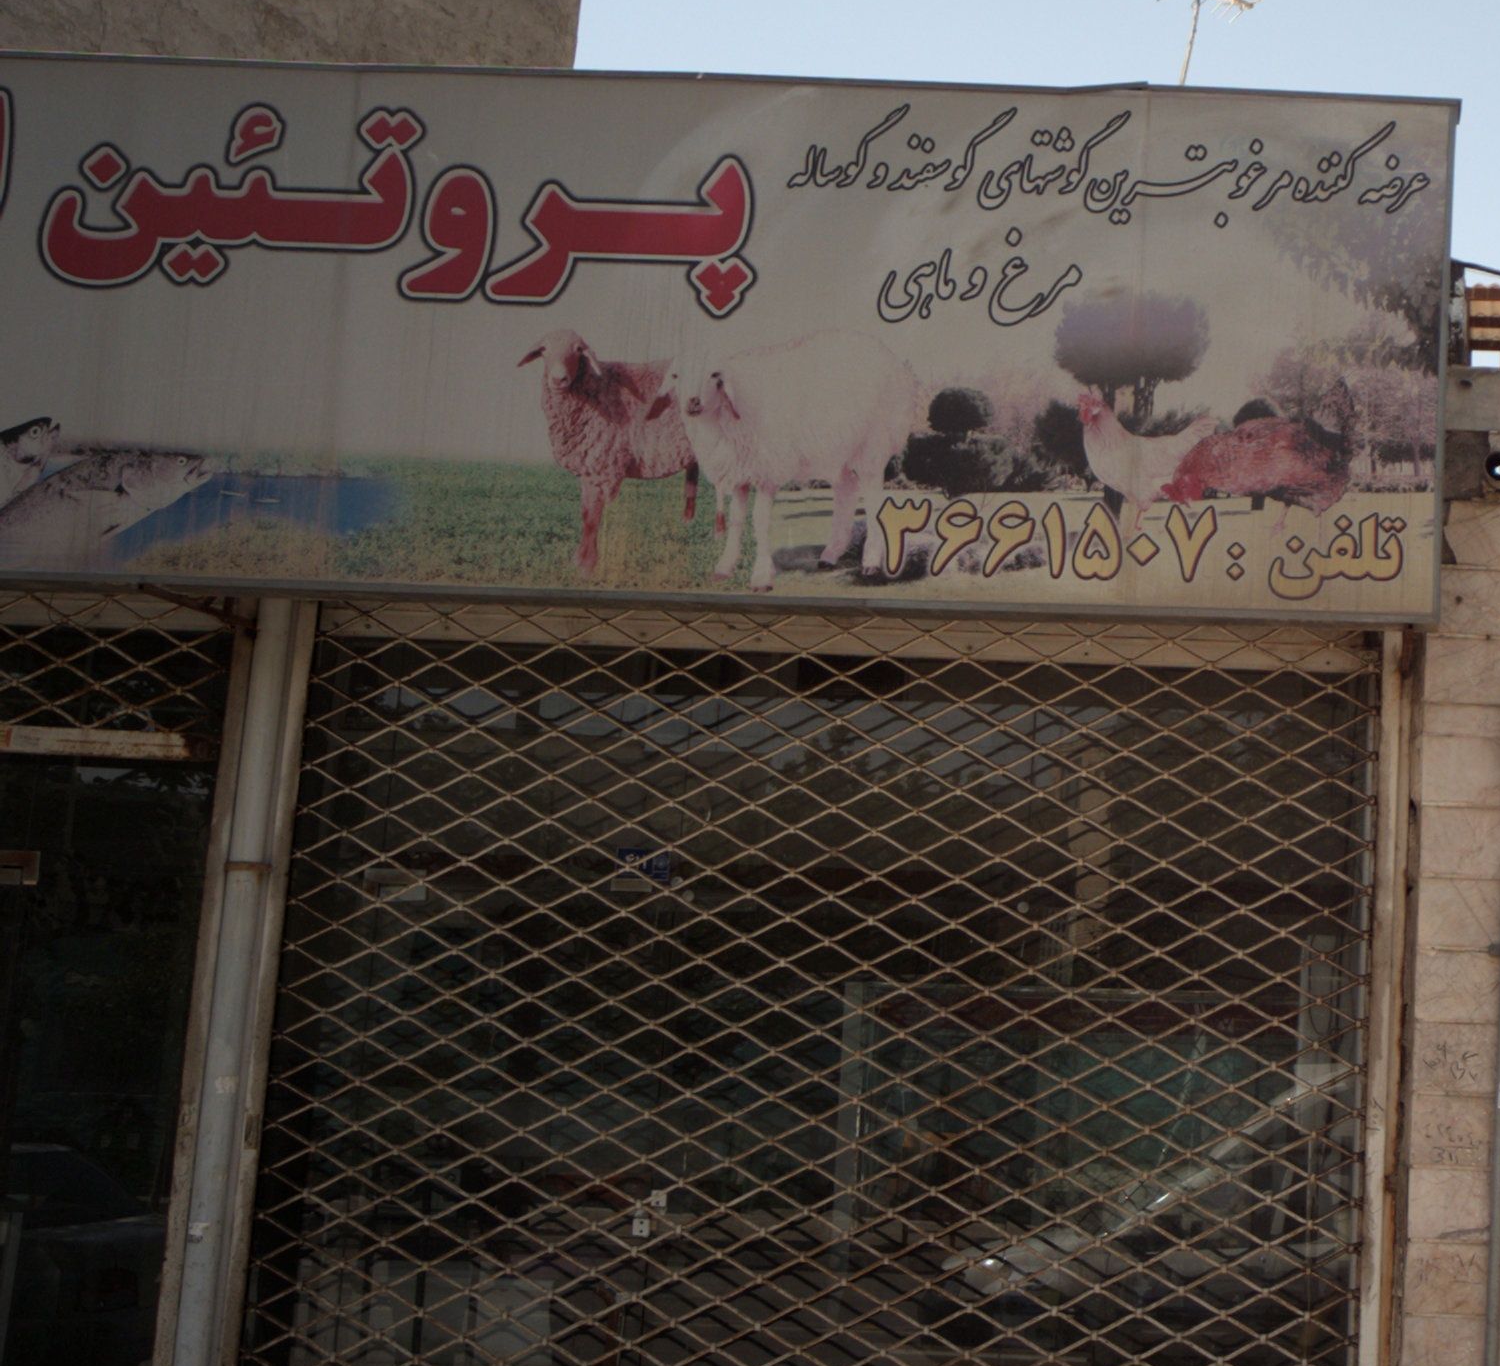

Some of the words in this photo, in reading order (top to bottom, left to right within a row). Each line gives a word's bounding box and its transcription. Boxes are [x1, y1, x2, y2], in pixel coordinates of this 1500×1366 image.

[786, 103, 911, 189] گوساله
[866, 162, 889, 189] و
[887, 107, 1017, 192] گوسفند
[1292, 120, 1396, 203] کننده
[1357, 153, 1430, 214] عرضه
[37, 101, 758, 319] پروتئین
[877, 247, 957, 323] ماهی
[959, 266, 988, 301] و
[988, 226, 1083, 326] مرغ
[876, 496, 1218, 583] ۳۶۶۱۵۰۷
